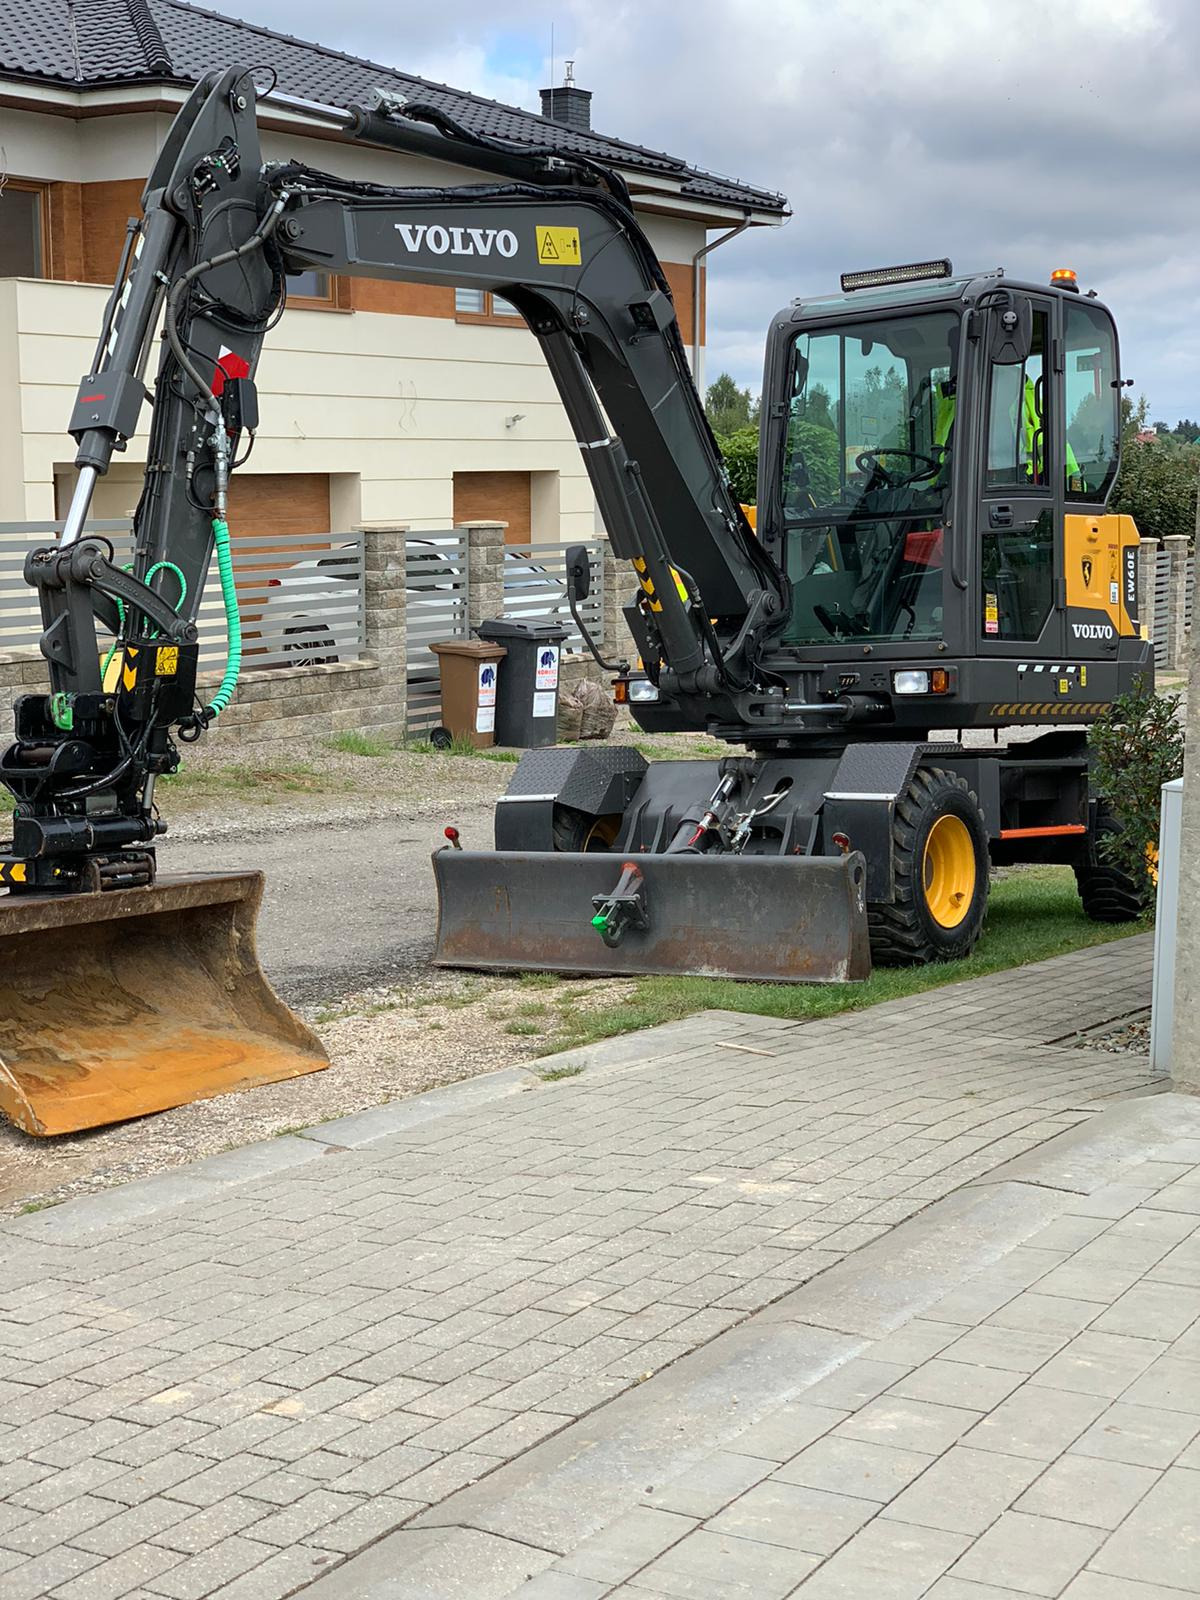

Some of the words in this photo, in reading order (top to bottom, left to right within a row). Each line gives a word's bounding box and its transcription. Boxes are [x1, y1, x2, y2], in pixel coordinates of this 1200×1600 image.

[394, 223, 519, 258] VOLVO
[1127, 551, 1135, 602] EW60E
[1071, 624, 1113, 639] VOLVO
